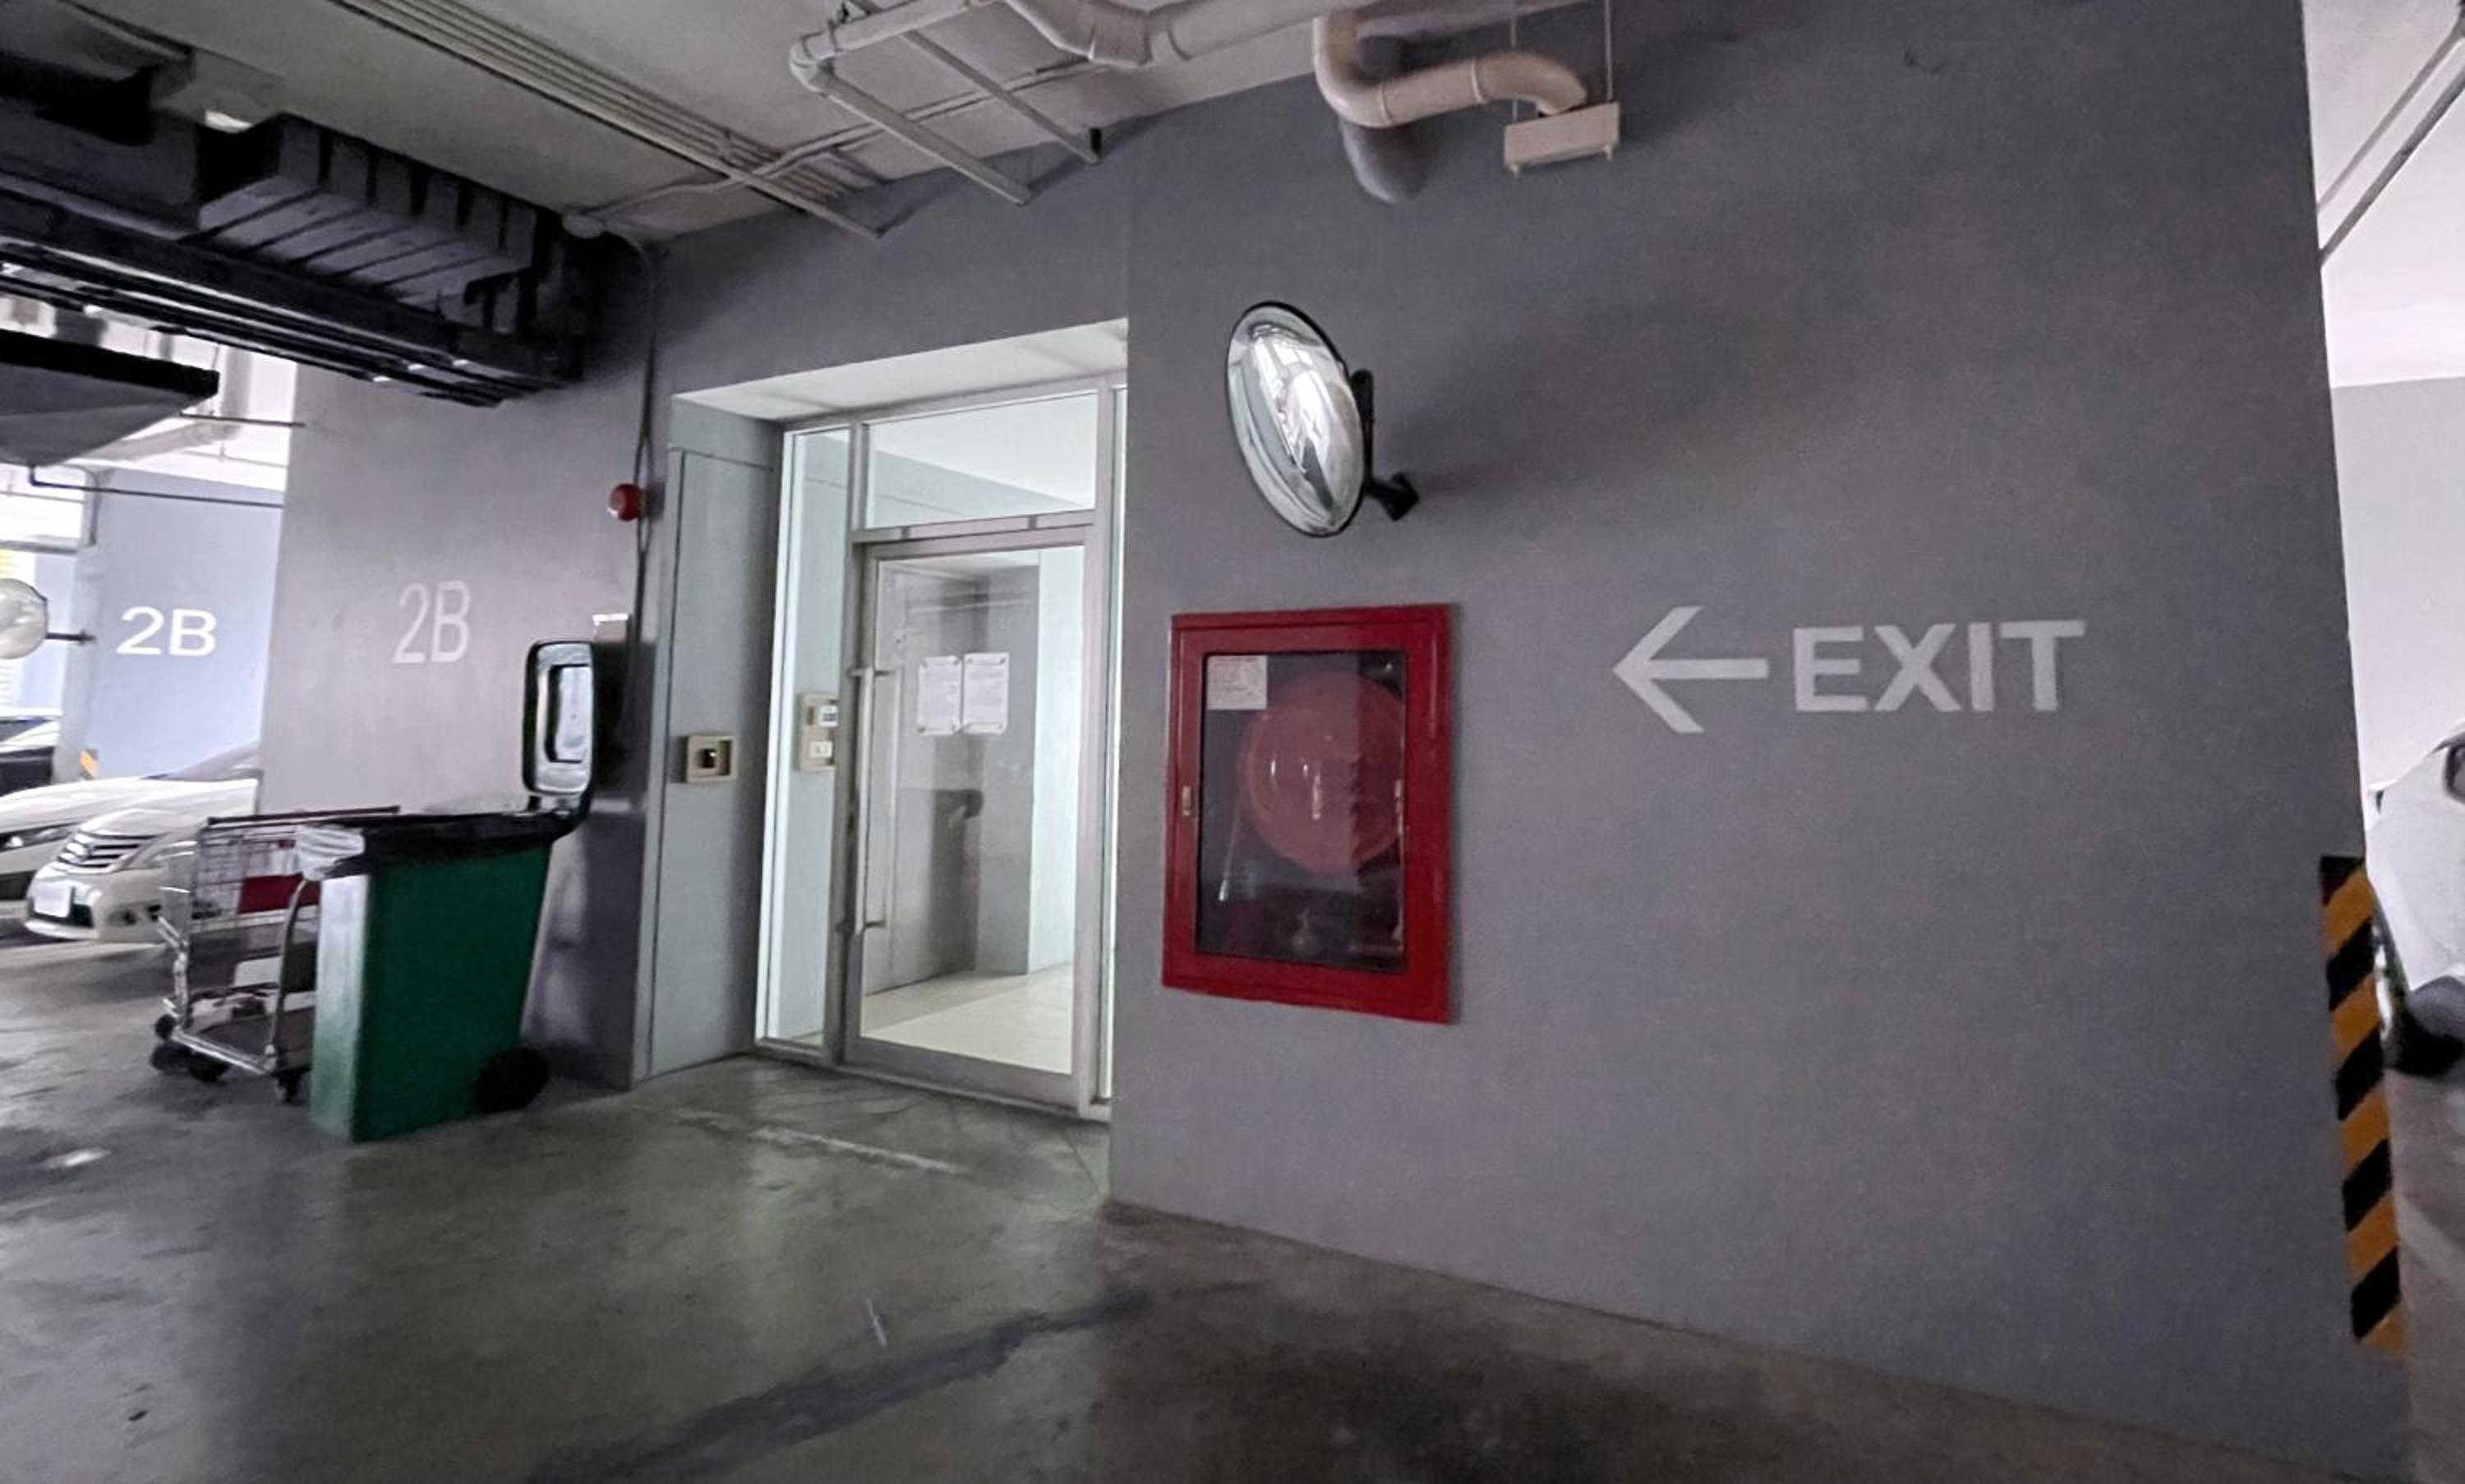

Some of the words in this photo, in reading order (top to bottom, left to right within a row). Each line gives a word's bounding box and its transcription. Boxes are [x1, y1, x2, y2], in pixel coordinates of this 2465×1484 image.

[116, 606, 218, 657] 2B
[392, 579, 472, 664] 2B
[1793, 619, 2088, 712] EXIT
